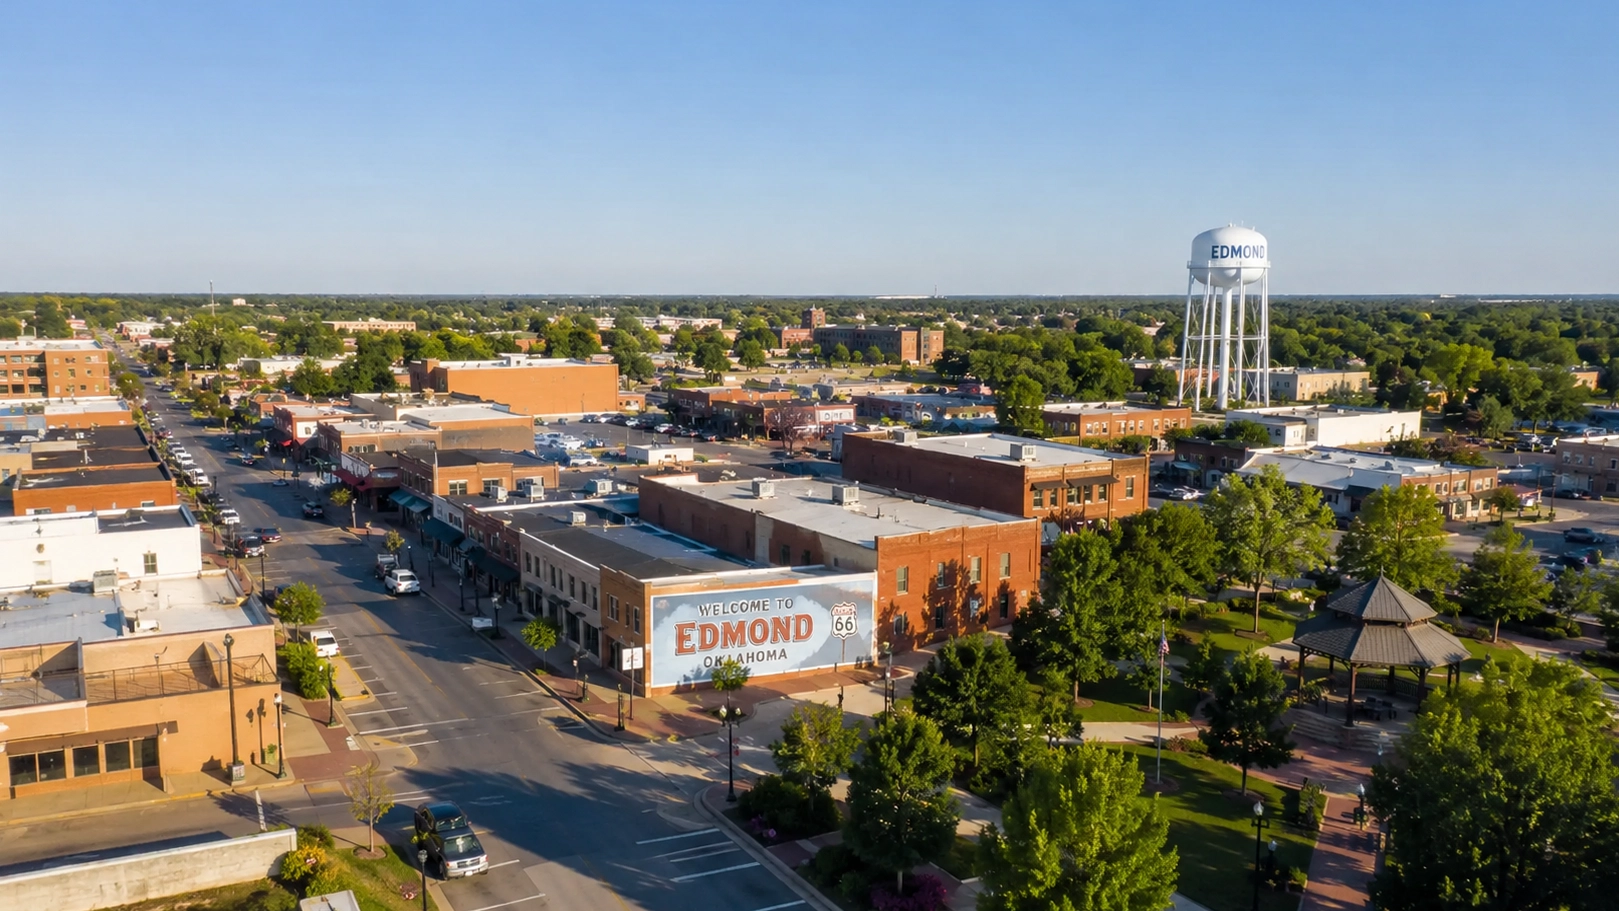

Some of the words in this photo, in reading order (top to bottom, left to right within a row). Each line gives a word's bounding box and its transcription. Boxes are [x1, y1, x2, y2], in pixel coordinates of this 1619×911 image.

[1211, 245, 1265, 259] EDMOND
[699, 600, 770, 616] WELCOME
[777, 598, 794, 610] TO
[835, 616, 854, 632] 66
[674, 614, 814, 656] EDMOND
[703, 648, 788, 669] OKAHOMA
